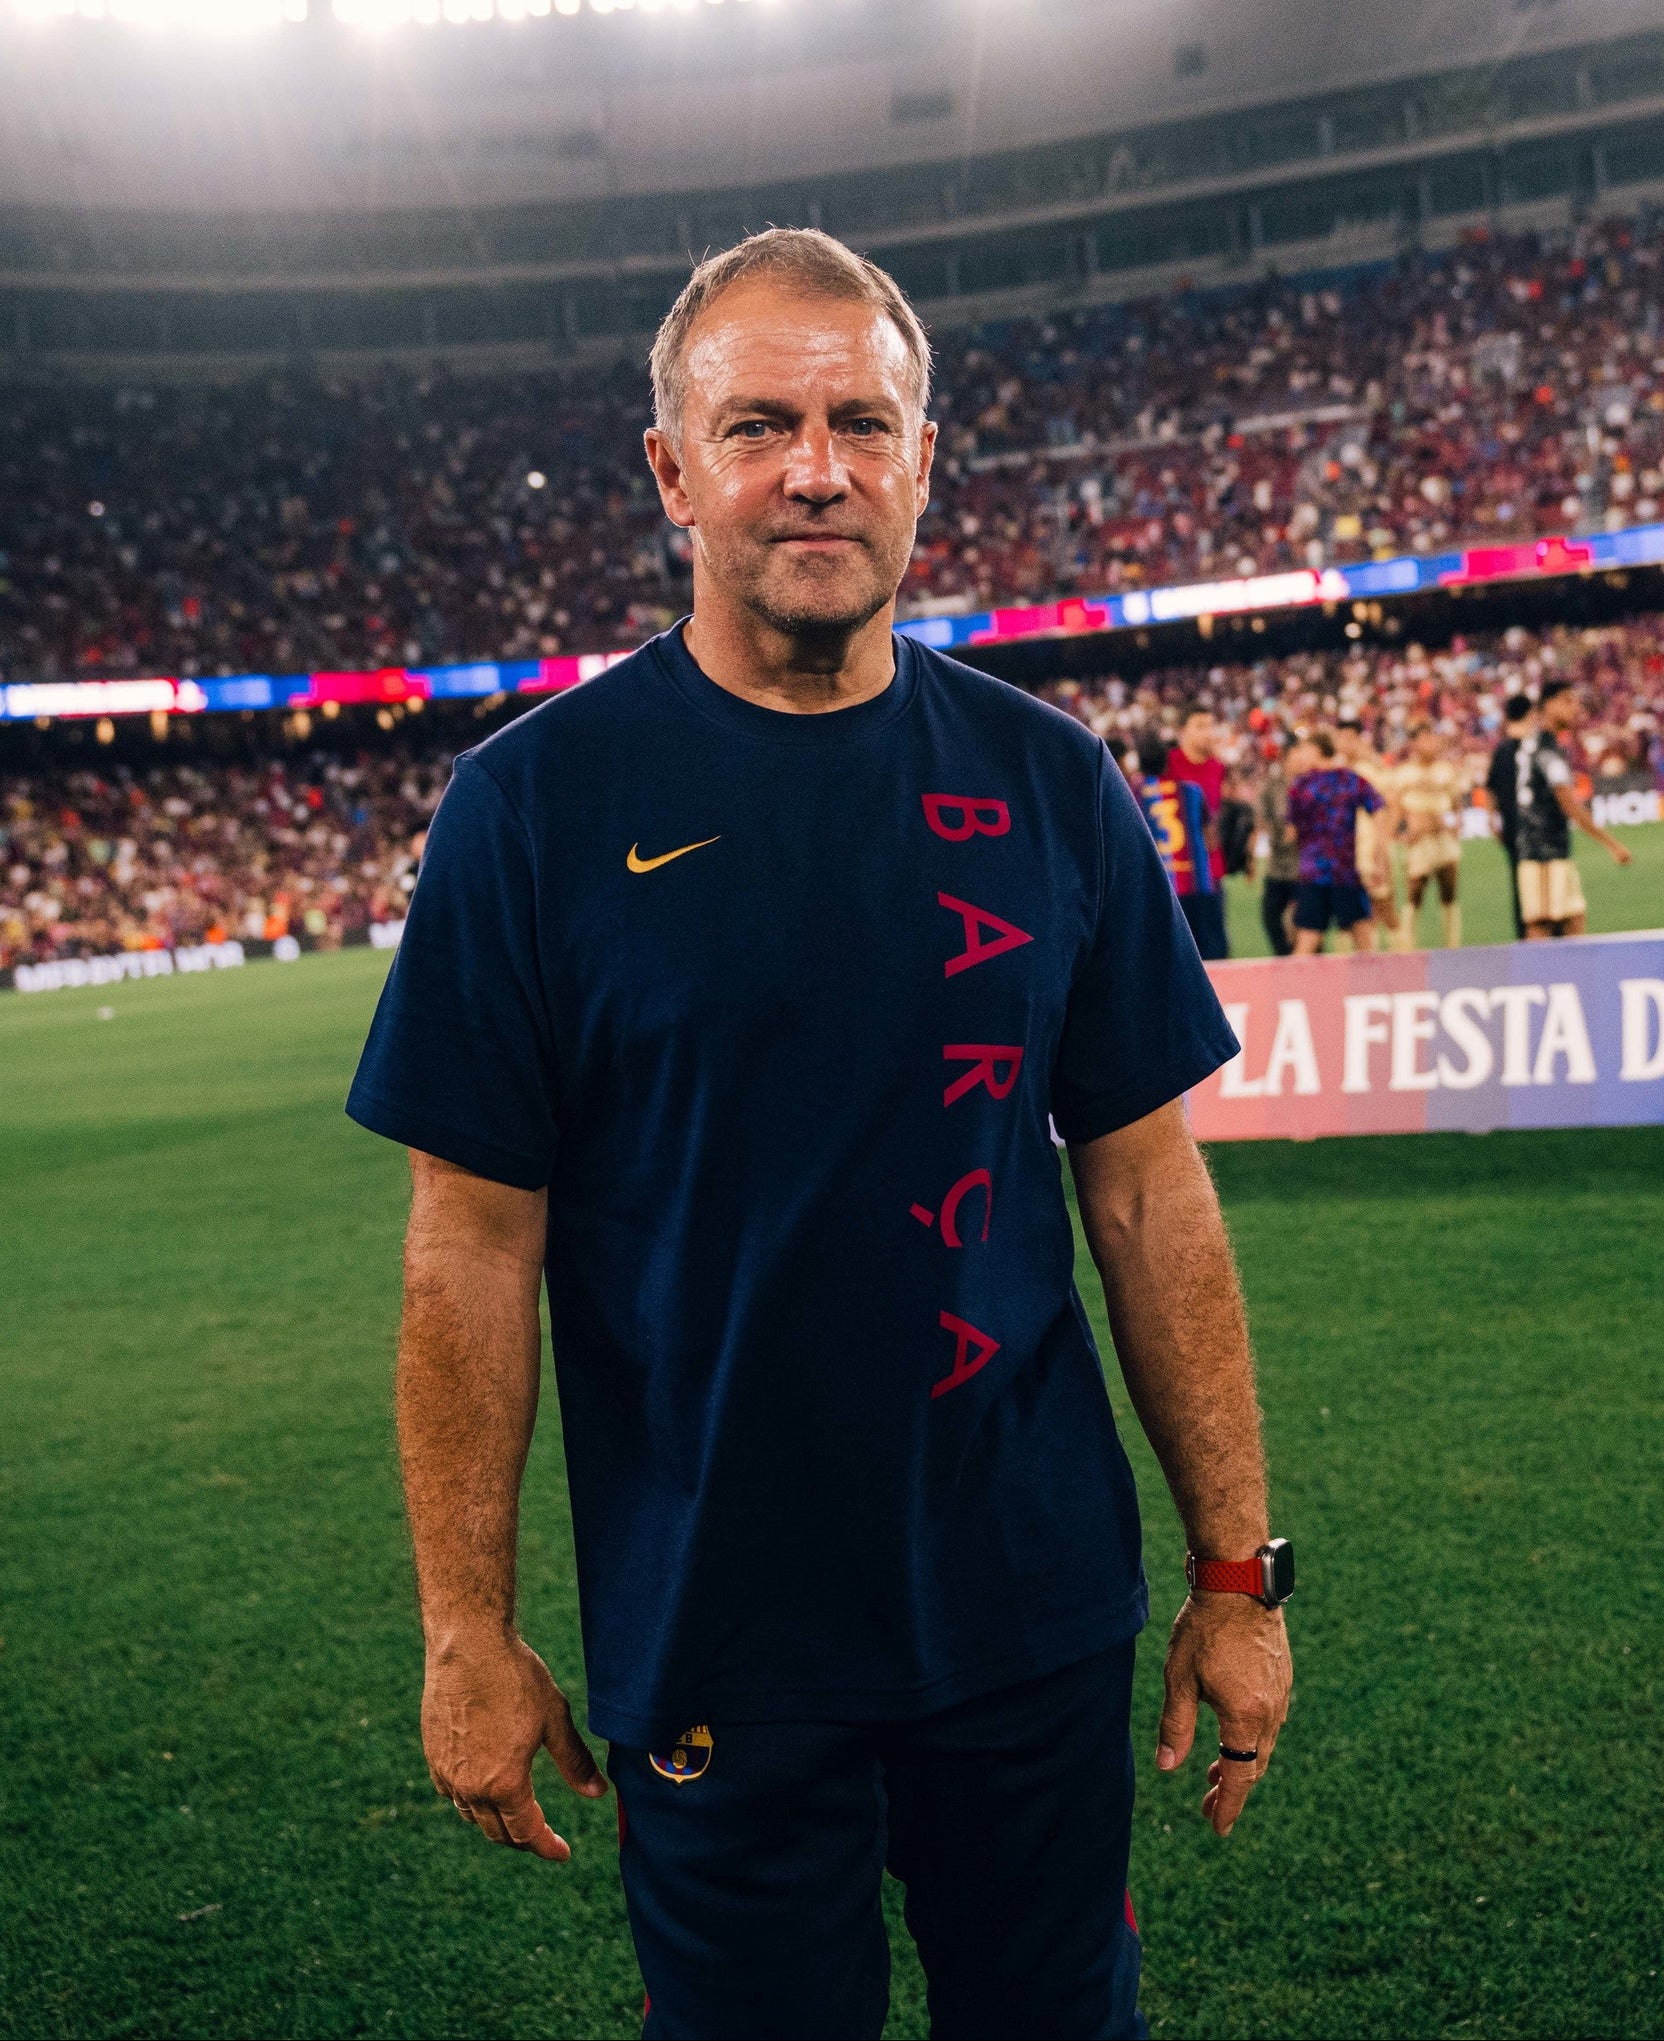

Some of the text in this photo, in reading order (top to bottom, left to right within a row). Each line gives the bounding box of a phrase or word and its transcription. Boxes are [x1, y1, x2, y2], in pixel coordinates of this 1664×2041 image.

[909, 793, 1034, 1399] BARÇA
[1219, 999, 1320, 1097] LA
[1341, 982, 1597, 1093] FESTA
